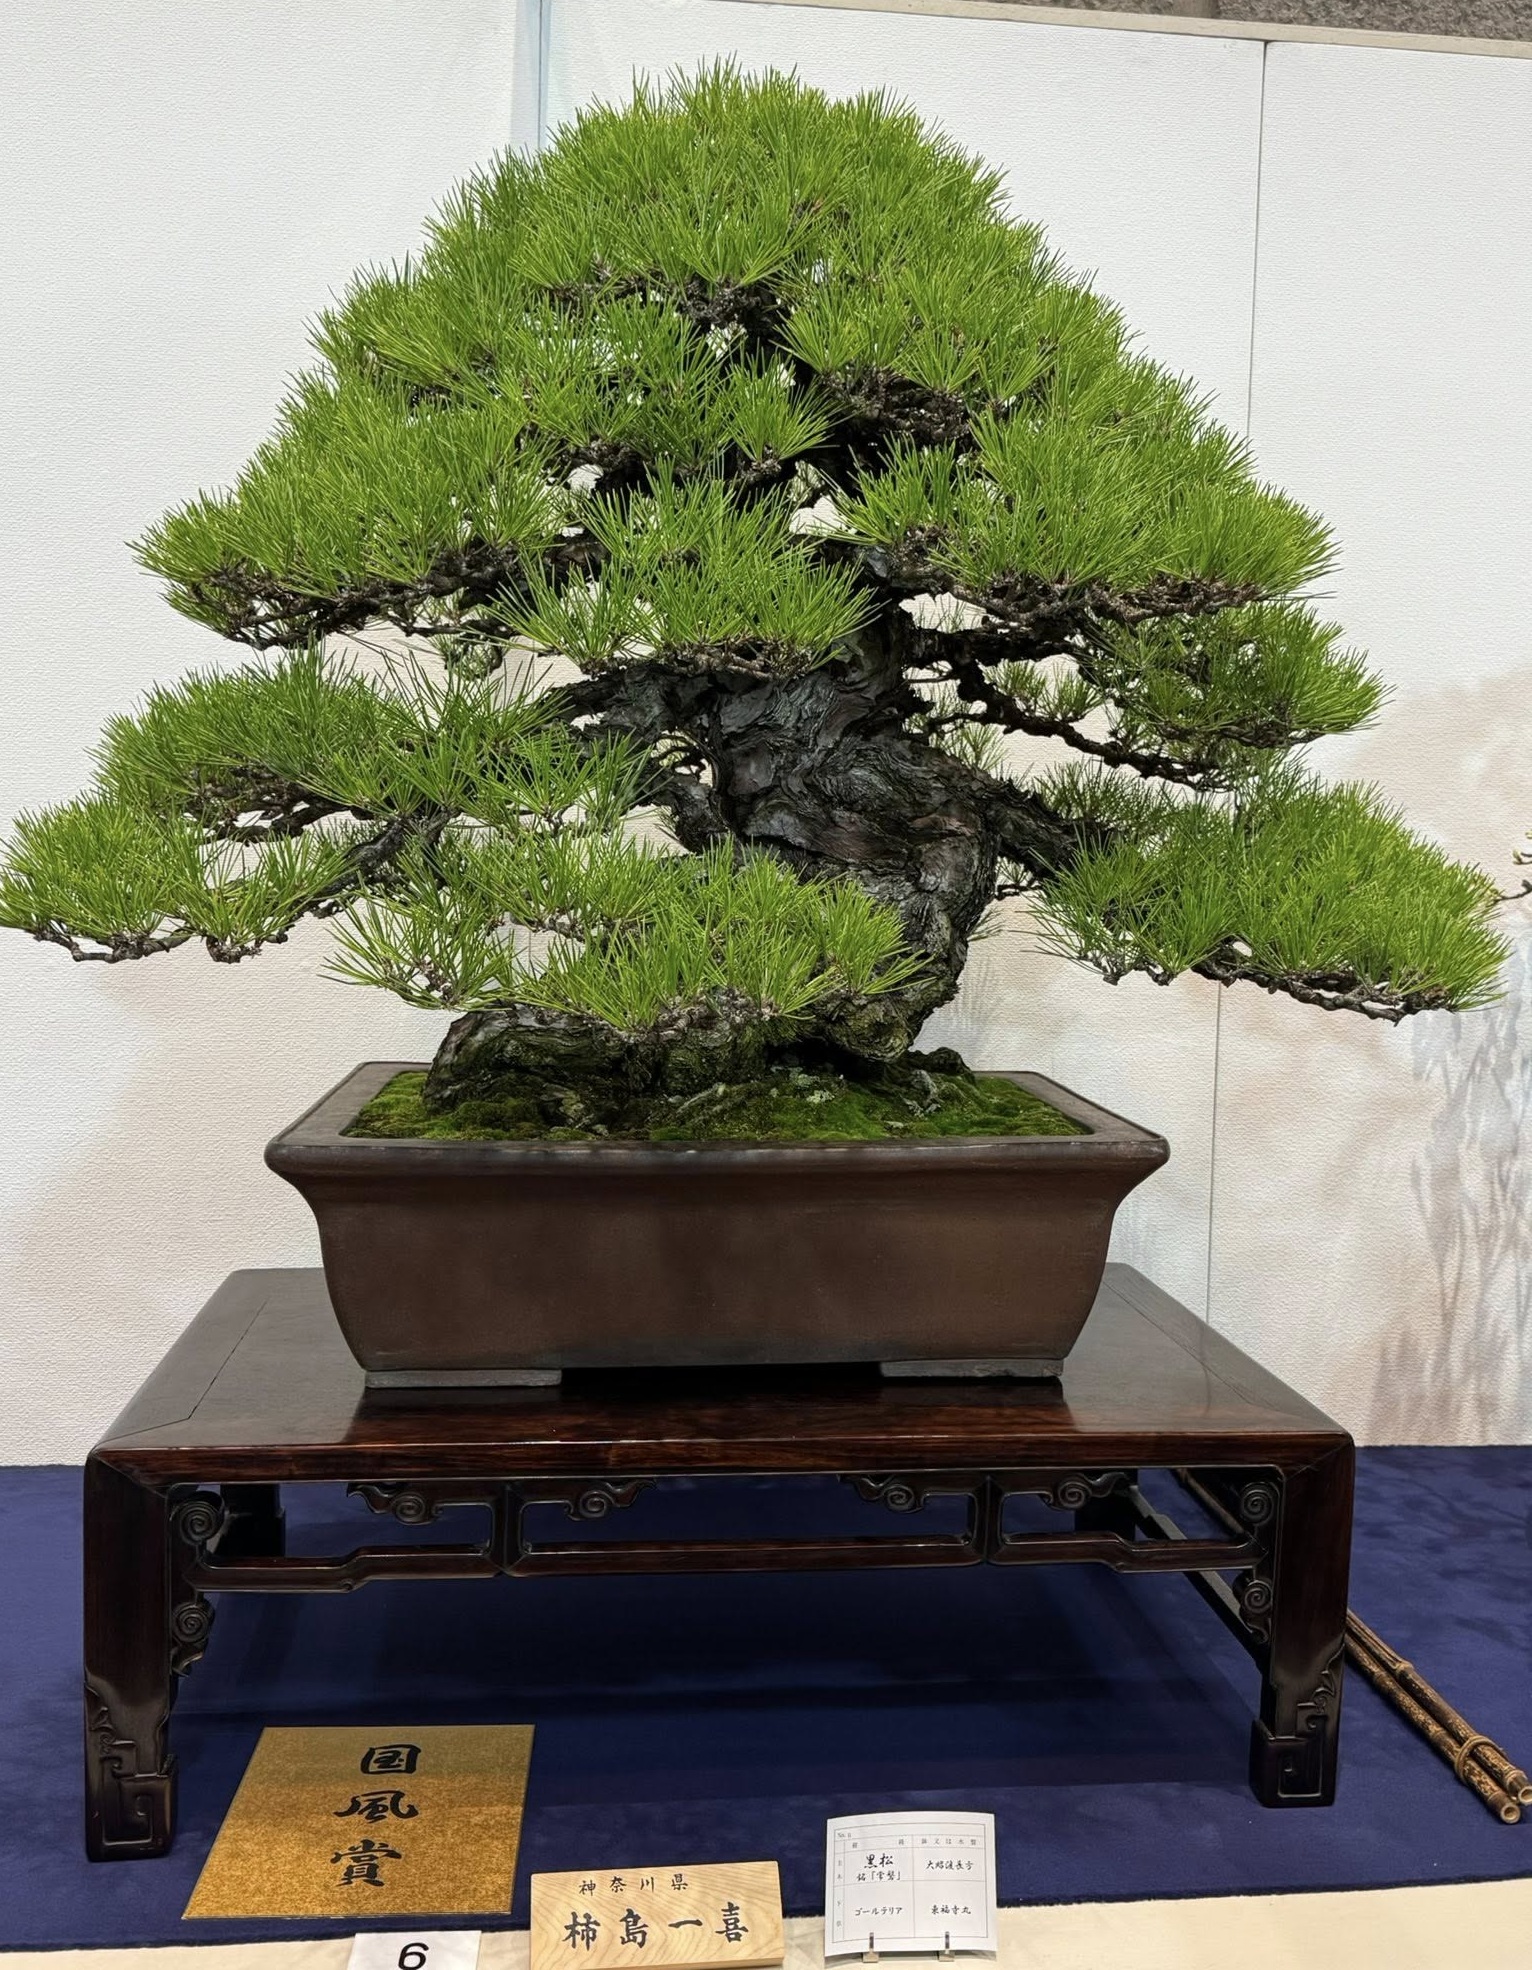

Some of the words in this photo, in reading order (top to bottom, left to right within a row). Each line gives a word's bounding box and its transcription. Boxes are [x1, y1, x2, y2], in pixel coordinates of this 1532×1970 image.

[330, 1743, 422, 1887] 国風賞
[864, 1852, 894, 1869] 黒松
[578, 1873, 689, 1897] 神奈川県
[561, 1901, 749, 1951] 柿島一喜
[398, 1942, 430, 1970] 6
